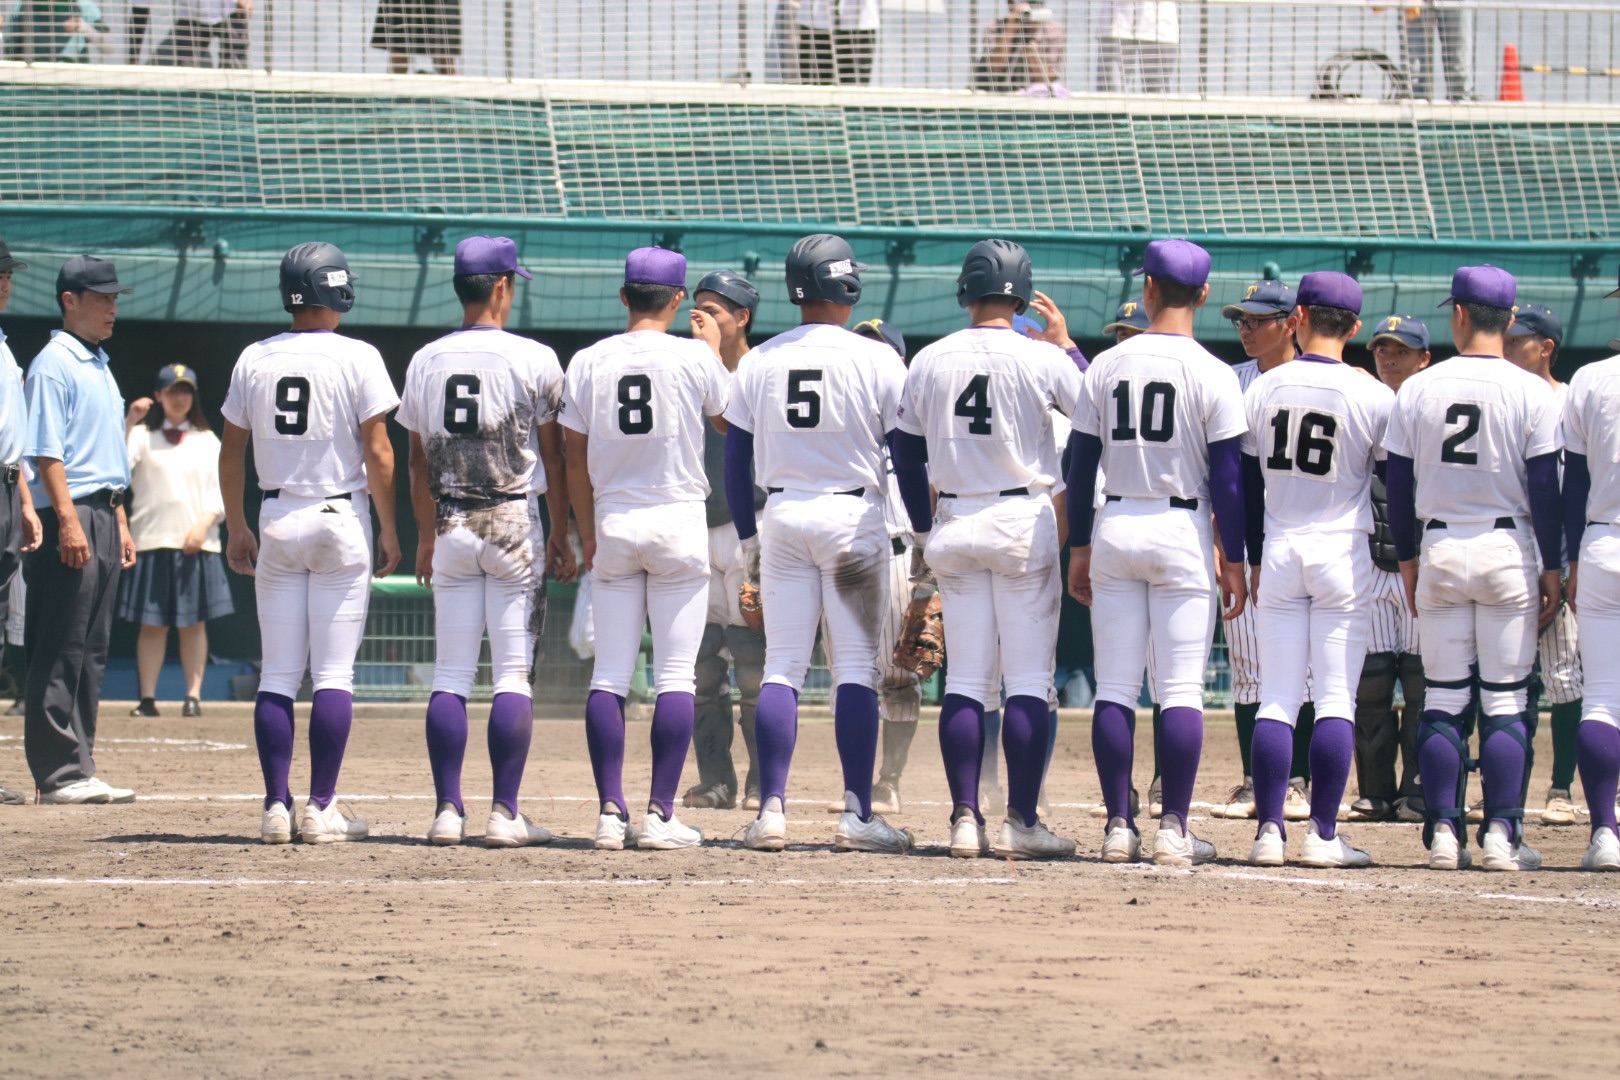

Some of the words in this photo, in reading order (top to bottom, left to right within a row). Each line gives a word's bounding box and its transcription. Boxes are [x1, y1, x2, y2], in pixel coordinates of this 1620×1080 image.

[291, 293, 304, 305] 12
[795, 287, 804, 298] 5
[1004, 282, 1013, 294] 2
[1123, 302, 1137, 317] T
[1246, 285, 1258, 300] T
[1387, 316, 1402, 331] T
[275, 377, 310, 435] 9
[444, 375, 481, 434] 6
[618, 375, 653, 435] 8
[787, 370, 822, 428] 5
[955, 375, 992, 435] 4
[1112, 381, 1175, 442] 10
[1267, 410, 1336, 476] 16
[1441, 404, 1481, 465] 2
